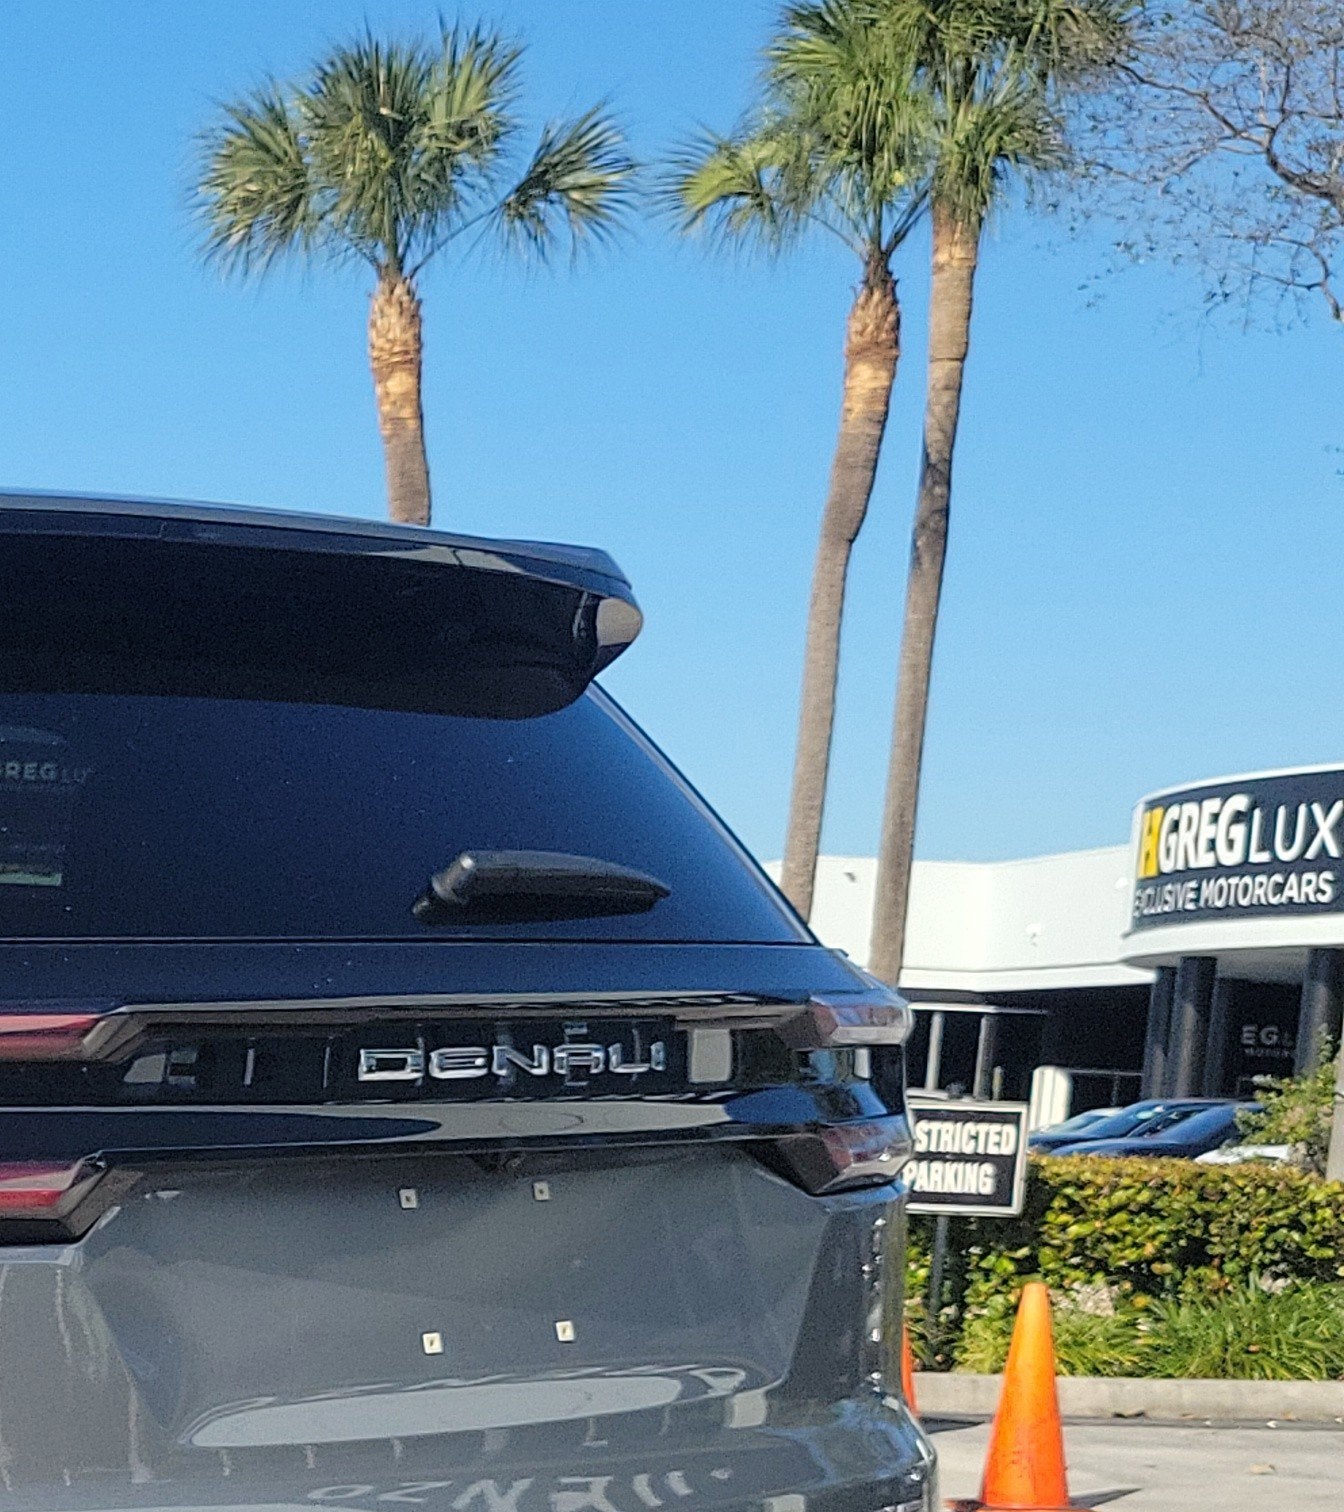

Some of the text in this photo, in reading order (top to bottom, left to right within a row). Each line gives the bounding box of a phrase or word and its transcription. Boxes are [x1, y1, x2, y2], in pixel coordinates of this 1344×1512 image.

[1199, 871, 1335, 907] MOTORCARS
[357, 1040, 665, 1082] DENALI
[914, 1119, 1019, 1156] STRICTED
[901, 1160, 998, 1195] PARKING
